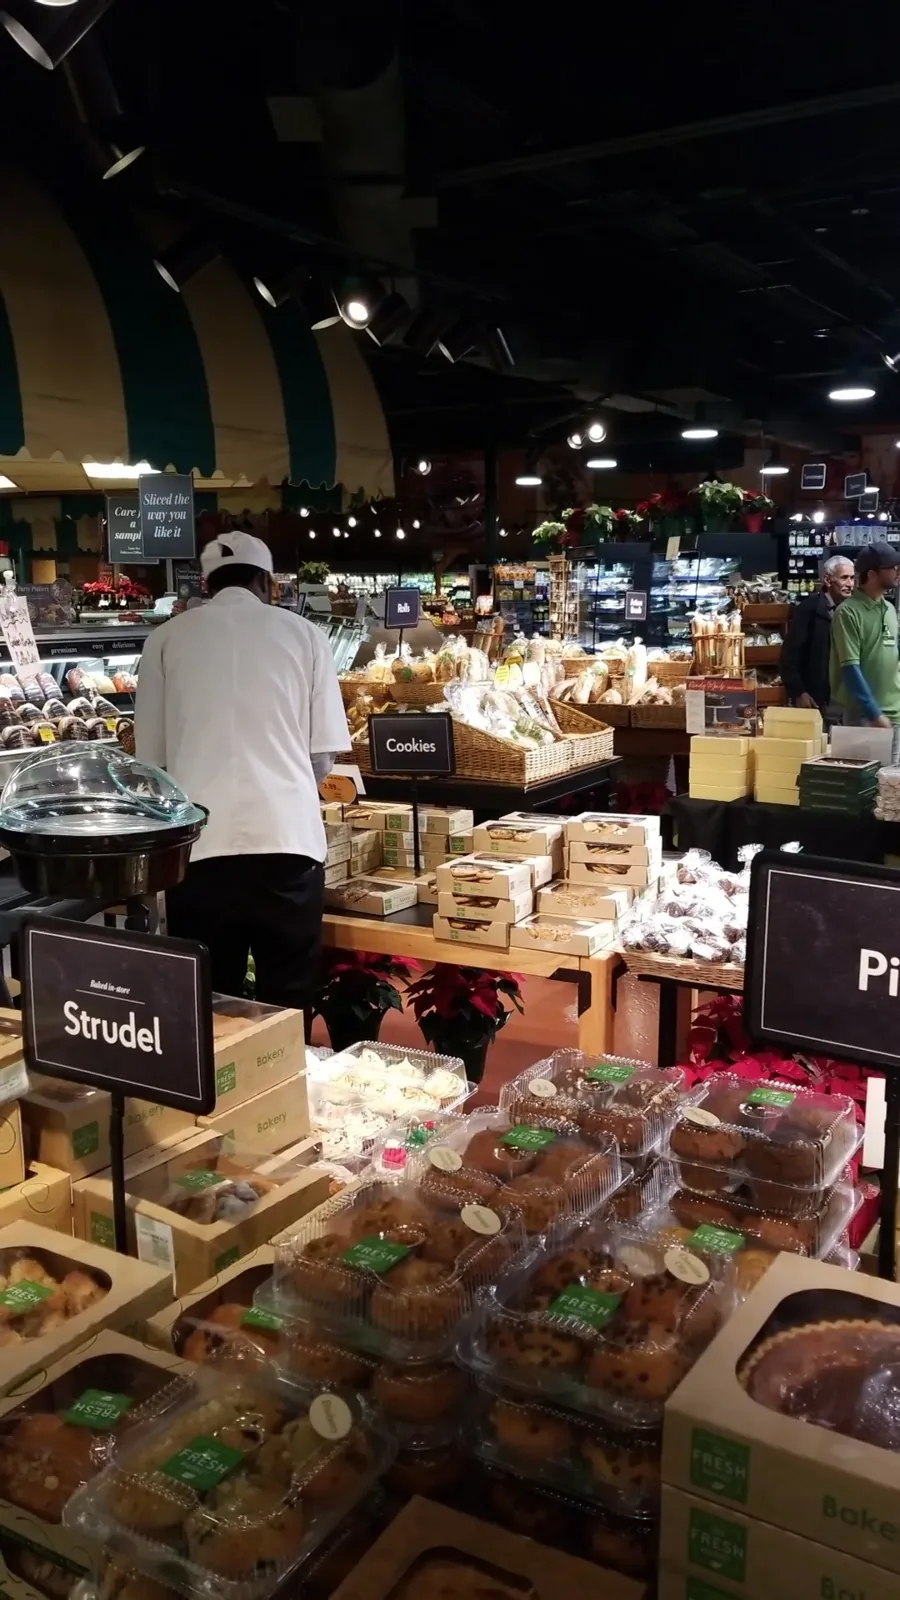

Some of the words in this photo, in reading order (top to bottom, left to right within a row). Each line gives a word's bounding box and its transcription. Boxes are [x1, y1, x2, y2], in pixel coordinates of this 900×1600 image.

[143, 493, 173, 506] Sliced
[174, 493, 190, 506] the
[114, 506, 137, 517] Care
[147, 511, 168, 523] way
[169, 511, 187, 523] you
[129, 520, 137, 529] a
[153, 526, 173, 538] like
[173, 526, 182, 538] it
[397, 602, 411, 614] Rolls
[50, 646, 78, 656] premium
[92, 643, 105, 651] easy
[386, 737, 437, 753] Cookies
[858, 948, 900, 997] Pi
[89, 979, 108, 991] Baked
[107, 982, 131, 995] in-store
[63, 1000, 163, 1056] Strudel
[256, 1046, 286, 1068] Bakery
[257, 1111, 288, 1134] Bakery
[353, 1243, 399, 1263] FRESH
[559, 1294, 611, 1317] FRESH
[72, 1402, 121, 1420] FRESH
[179, 1447, 230, 1475] FRESH
[692, 1448, 747, 1480] FRESH
[822, 1493, 899, 1543] Bake
[690, 1526, 745, 1561] FRESH
